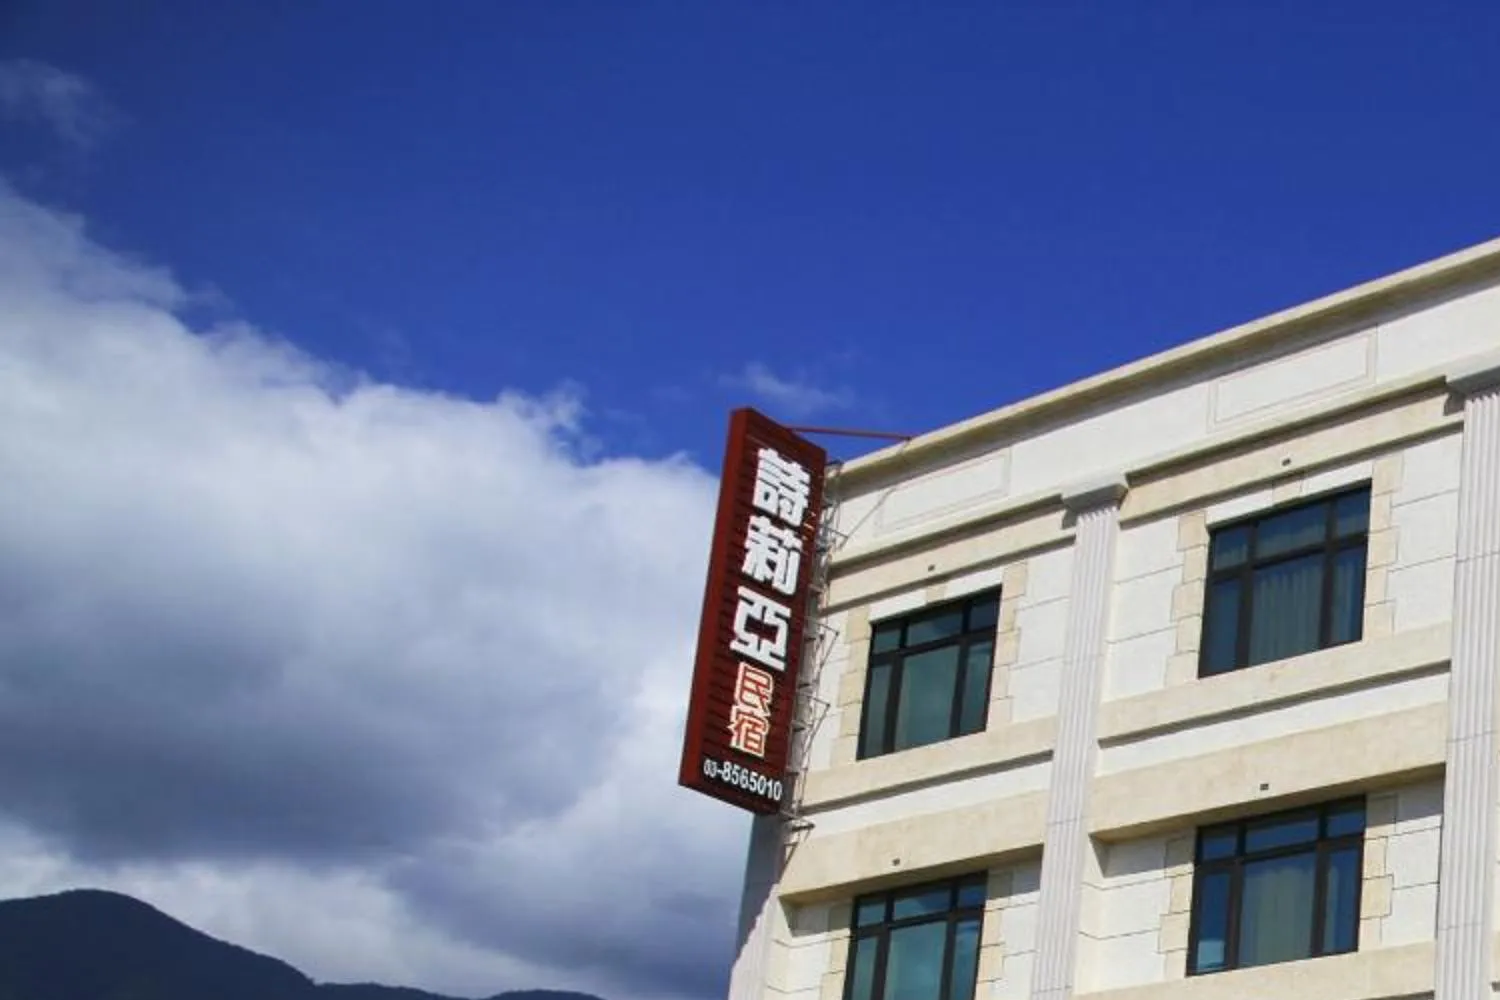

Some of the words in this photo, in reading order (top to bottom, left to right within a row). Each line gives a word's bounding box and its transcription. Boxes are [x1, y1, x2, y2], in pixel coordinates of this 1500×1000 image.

[729, 447, 811, 672] 詩莉亞
[729, 661, 774, 758] 民宿
[703, 758, 783, 802] 03-8565010
